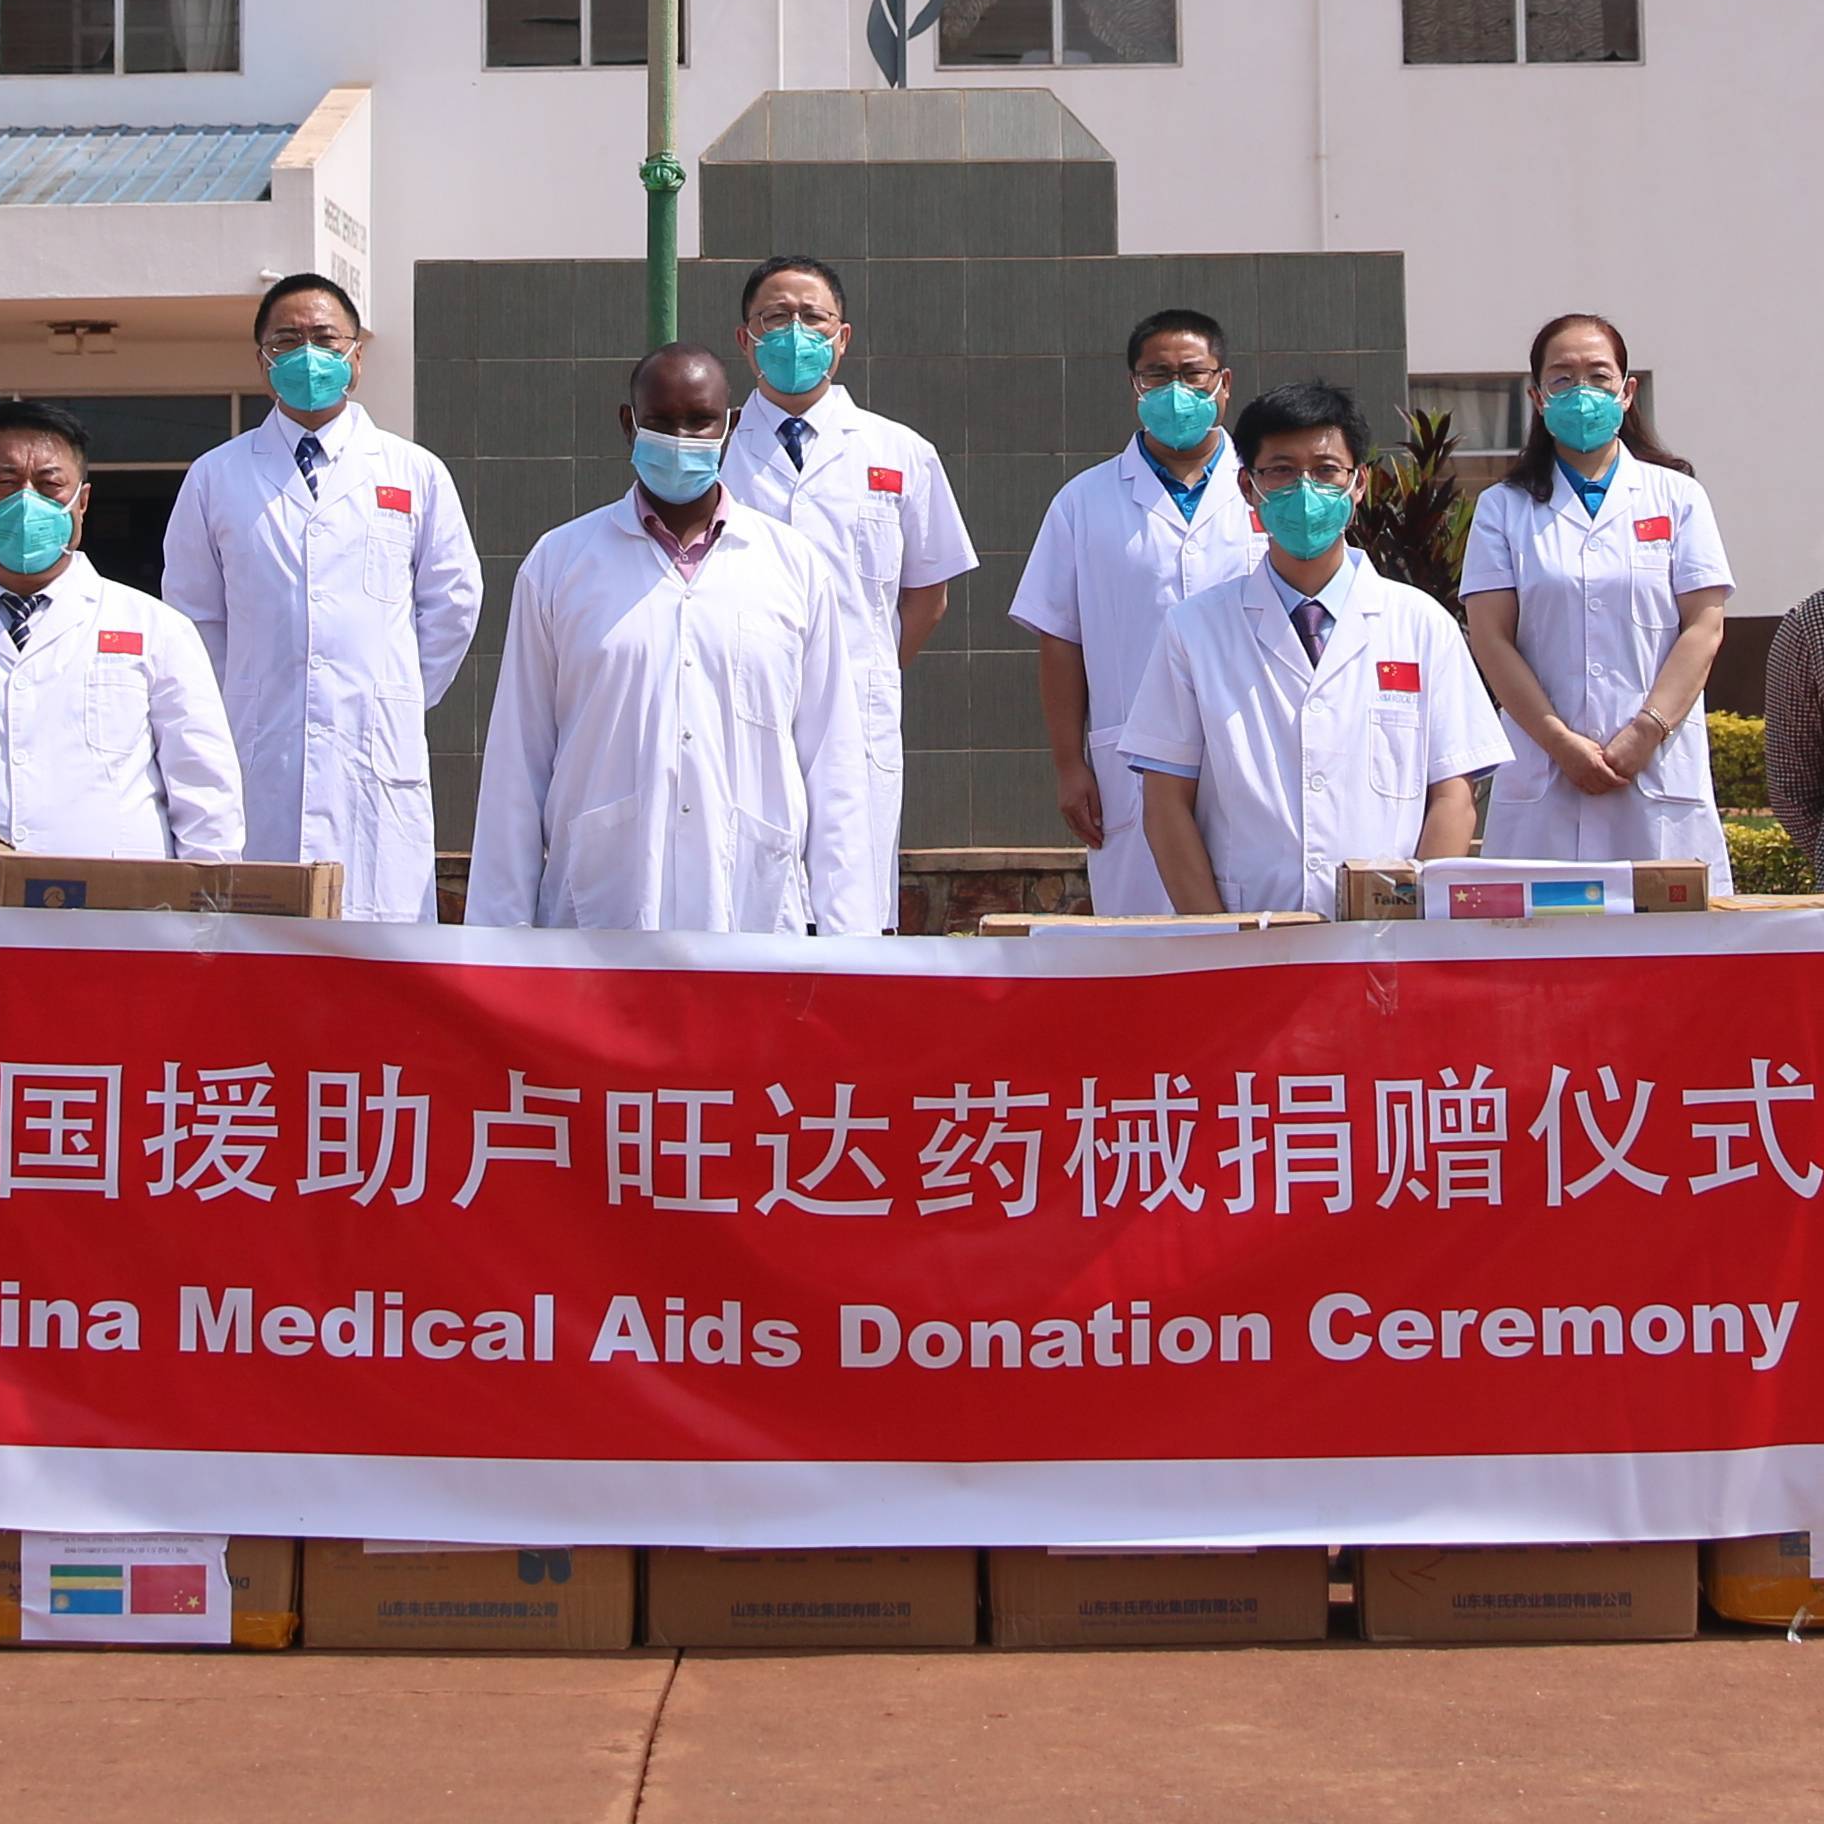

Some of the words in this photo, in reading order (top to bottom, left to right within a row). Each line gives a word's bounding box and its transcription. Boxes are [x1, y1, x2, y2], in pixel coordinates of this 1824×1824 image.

[179, 1286, 553, 1360] Medical
[589, 1295, 801, 1367] Aids
[840, 1300, 1270, 1368] Donation
[1309, 1292, 1799, 1370] Ceremony
